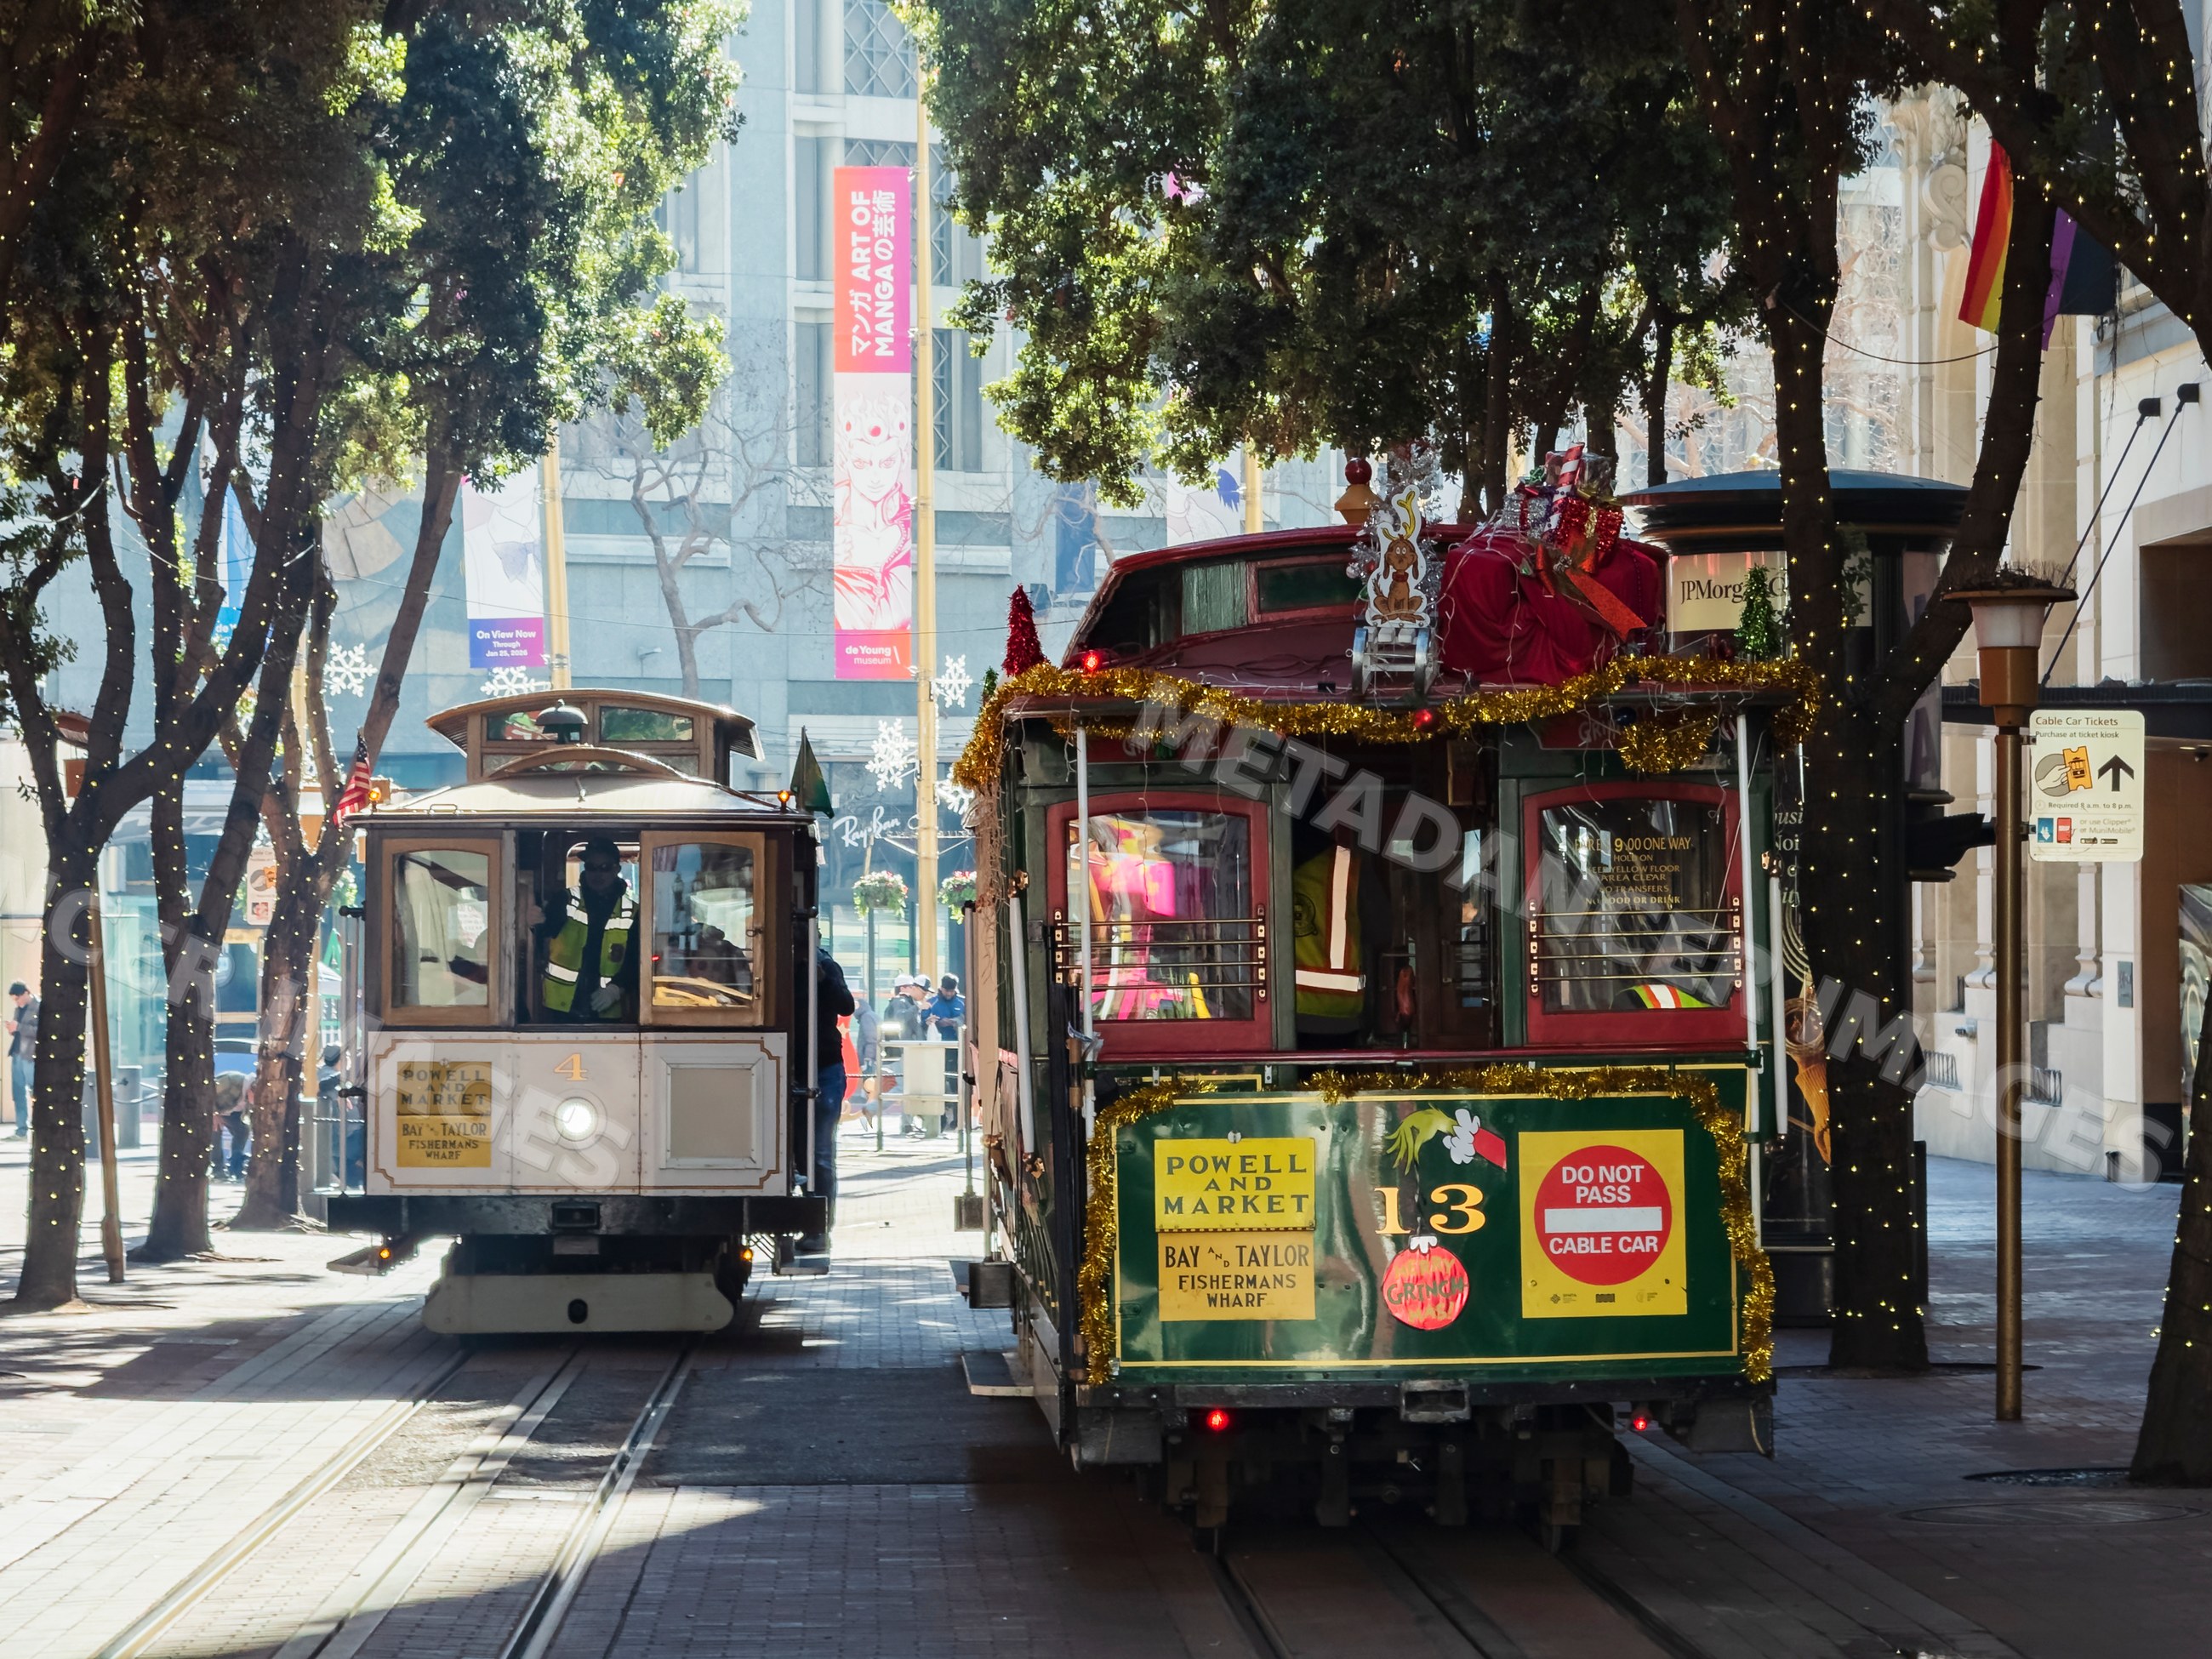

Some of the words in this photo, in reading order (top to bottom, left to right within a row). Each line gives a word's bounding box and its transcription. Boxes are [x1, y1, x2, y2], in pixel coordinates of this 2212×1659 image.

[852, 191, 871, 226] OF
[852, 231, 871, 282] ART
[849, 289, 872, 356] マンガ
[476, 630, 490, 639] On
[491, 630, 514, 639] View
[516, 630, 537, 638] Now
[493, 641, 521, 649] Through
[845, 646, 858, 654] de
[859, 646, 892, 657] Young
[2035, 716, 2063, 726] Cable
[2066, 716, 2082, 726] Car
[2085, 716, 2118, 726] Tickets
[1644, 837, 1666, 849] ONE
[1668, 836, 1691, 850] WAY
[1650, 864, 1680, 873] FLOOR
[1633, 873, 1667, 881] CLEAR
[1616, 885, 1670, 893] TRANSFERS
[1633, 896, 1647, 904] OR
[1650, 896, 1681, 904] DRINK
[554, 1052, 588, 1081] 4
[402, 1069, 485, 1082] POWELL
[425, 1082, 465, 1092] AND
[401, 1093, 486, 1105] MARKET
[402, 1123, 422, 1136] BAY
[441, 1122, 487, 1137] TAYLOR
[408, 1139, 478, 1149] FISHERMANS
[425, 1151, 461, 1160] WHARF
[1166, 1154, 1307, 1175] POWELL
[1562, 1166, 1594, 1183] DO
[1599, 1165, 1645, 1183] NOT
[1204, 1177, 1272, 1191] AND
[1576, 1185, 1631, 1203] PASS
[1164, 1194, 1309, 1214] MARKET
[1549, 1236, 1612, 1254] CABLE
[1618, 1235, 1658, 1252] CAR
[1165, 1246, 1200, 1268] BAY
[1207, 1246, 1230, 1268] AND
[1235, 1245, 1309, 1267] TAYLOR
[1394, 1255, 1455, 1279] MERRY
[1178, 1274, 1297, 1290] FISHERMANS
[1206, 1293, 1268, 1308] WHARF
